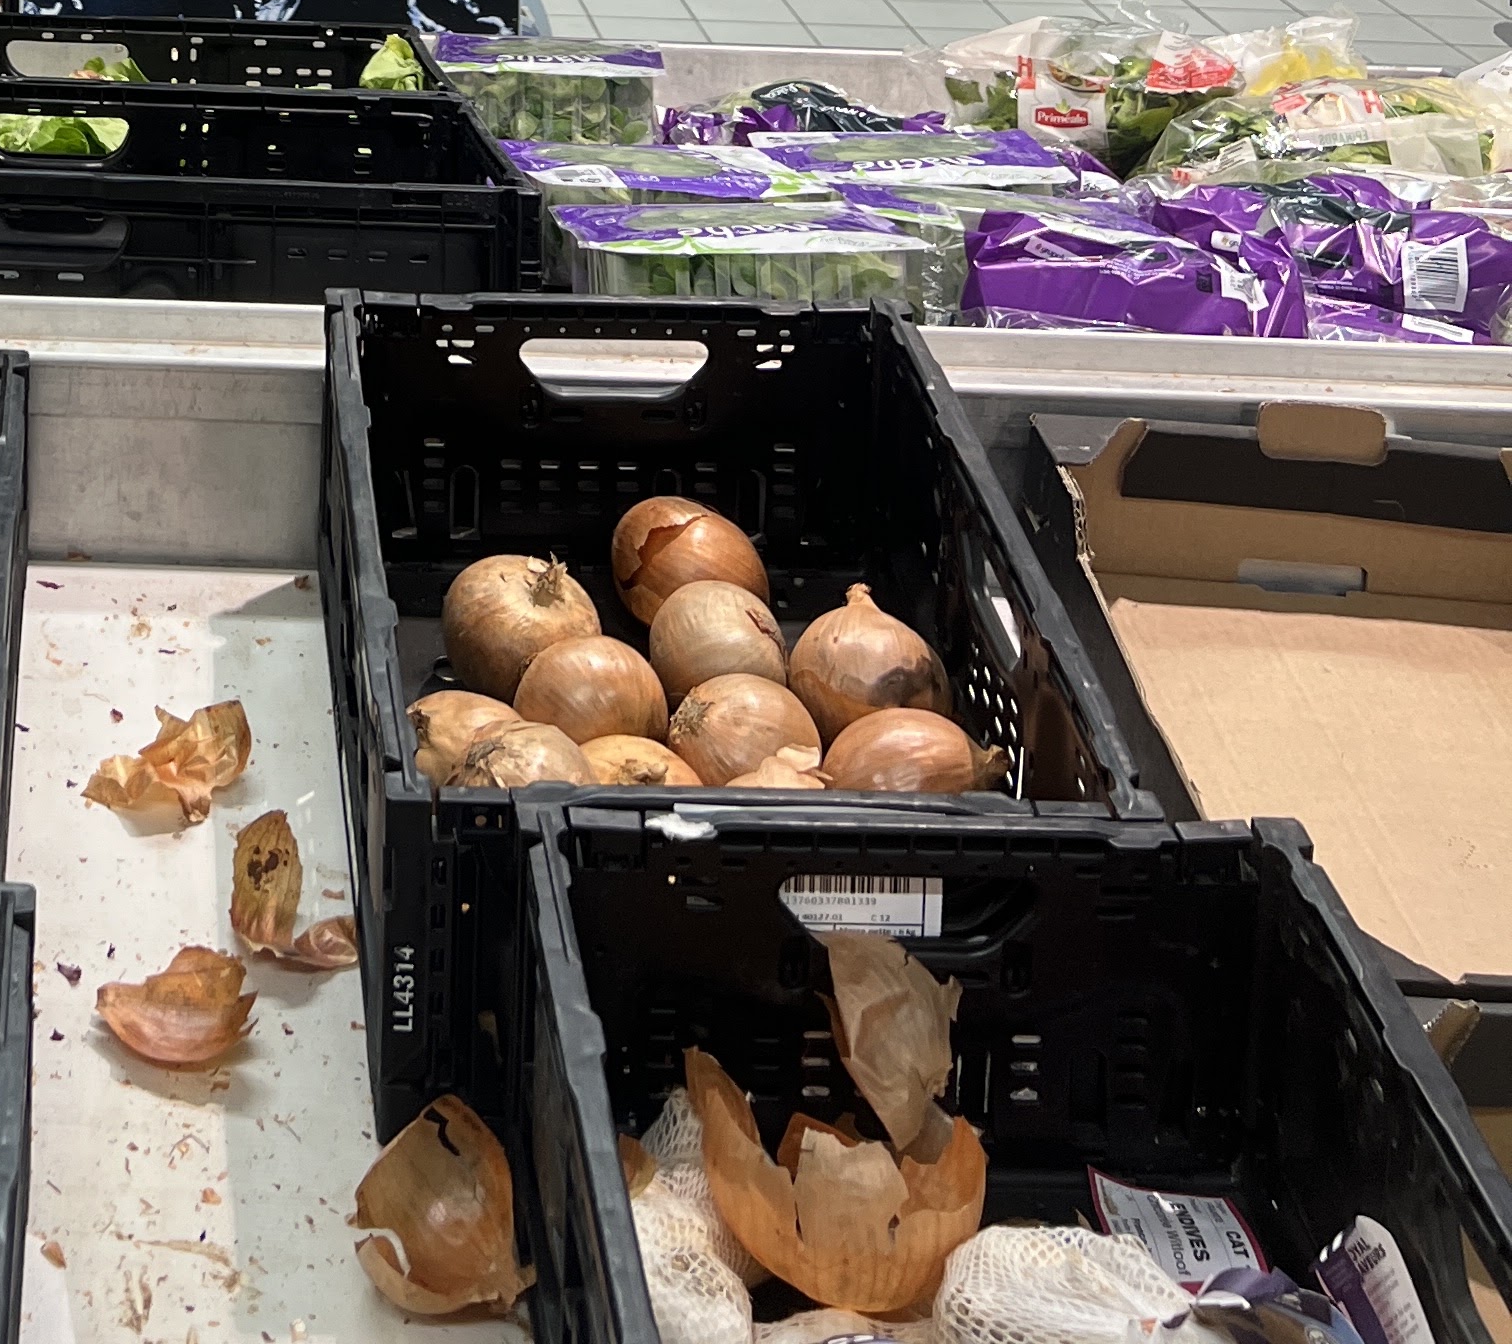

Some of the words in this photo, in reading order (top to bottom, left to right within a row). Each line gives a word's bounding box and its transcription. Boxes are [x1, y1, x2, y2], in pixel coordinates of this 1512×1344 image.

[392, 944, 415, 1032] LL4314
[1167, 1227, 1192, 1277] Witloof
[1170, 1201, 1211, 1263] ENDIVES
[1225, 1229, 1250, 1259] CAT
